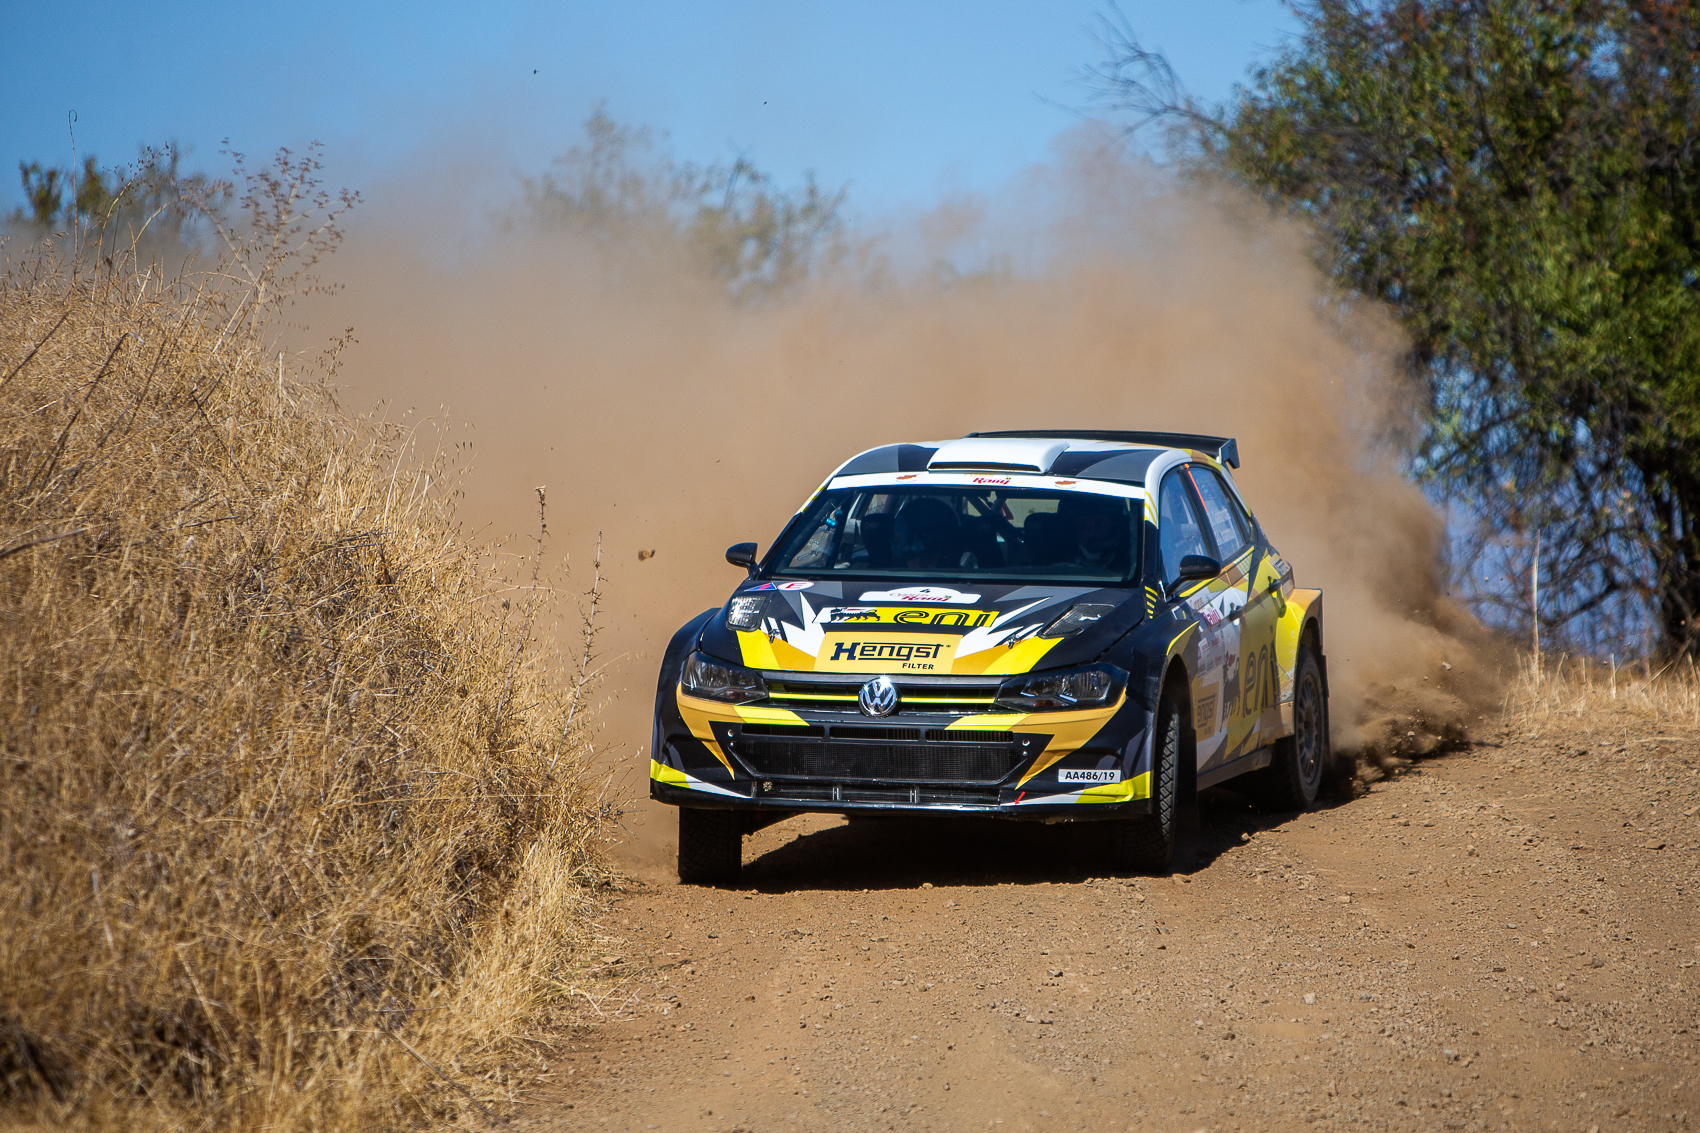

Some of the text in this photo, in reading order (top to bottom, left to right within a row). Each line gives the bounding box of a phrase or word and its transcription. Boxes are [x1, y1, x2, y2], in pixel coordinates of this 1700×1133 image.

[893, 610, 993, 627] eni
[830, 642, 945, 661] Hengst
[902, 662, 935, 670] FILTER
[1065, 771, 1115, 782] AA486/19
